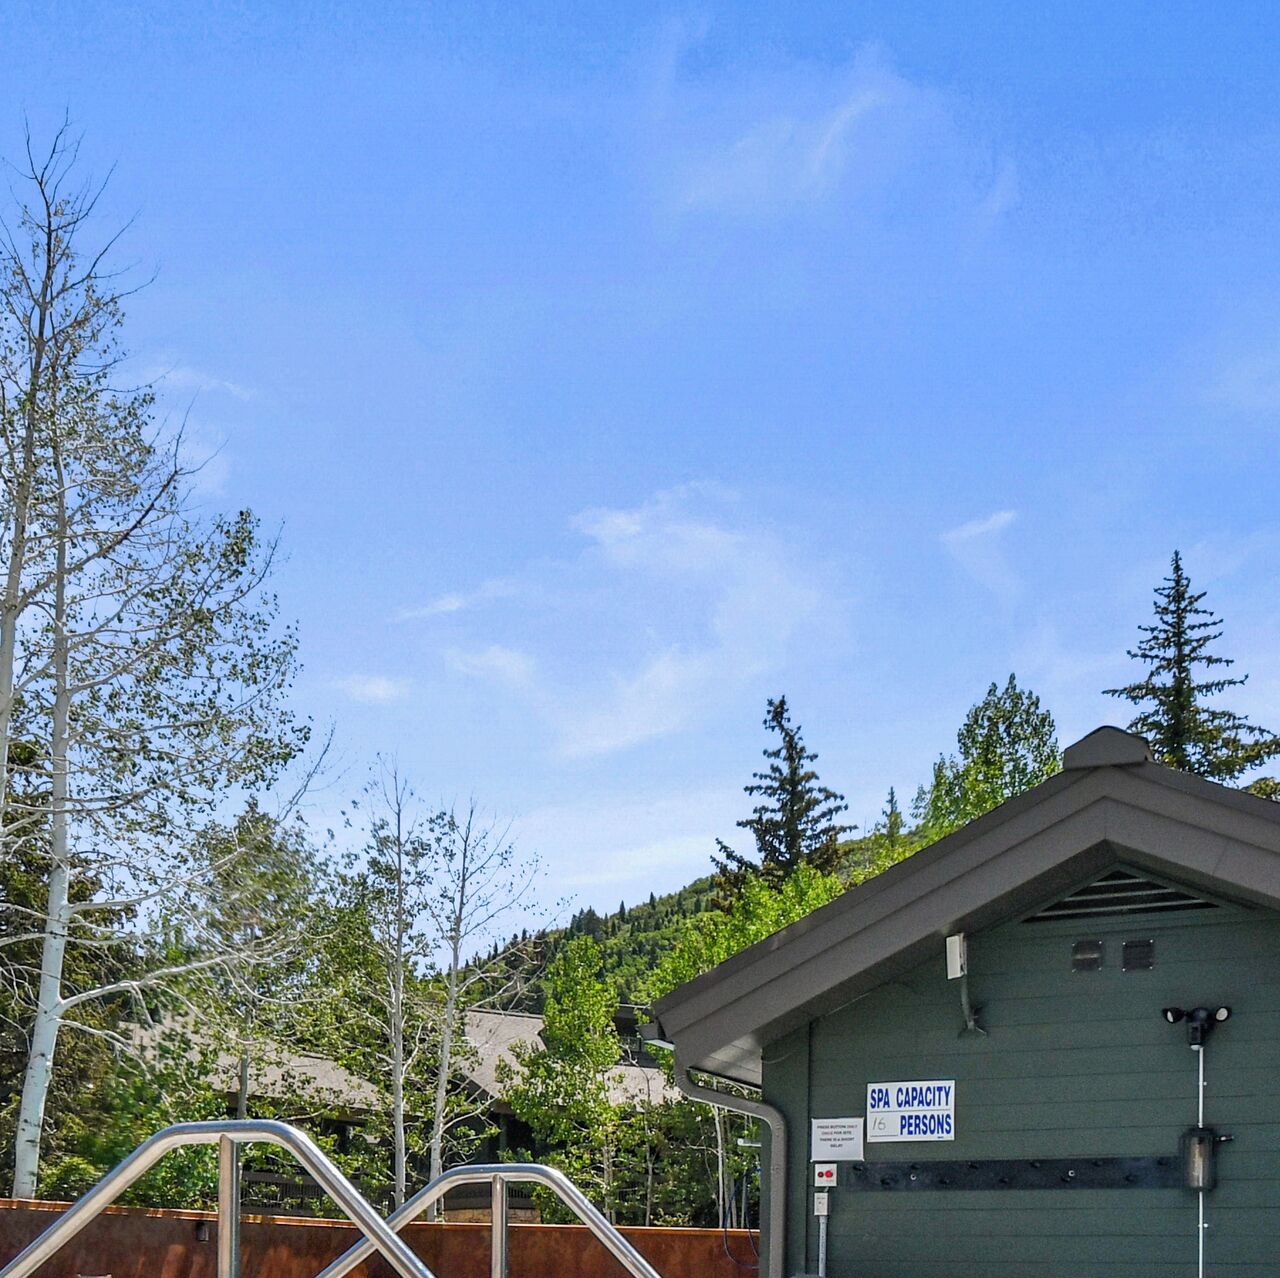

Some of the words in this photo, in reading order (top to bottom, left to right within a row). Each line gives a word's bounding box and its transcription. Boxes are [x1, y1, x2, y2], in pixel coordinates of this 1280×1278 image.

[870, 1088, 890, 1109] SPA
[896, 1086, 951, 1107] CAPACITY
[872, 1117, 886, 1130] 16
[900, 1114, 951, 1135] PERSONS
